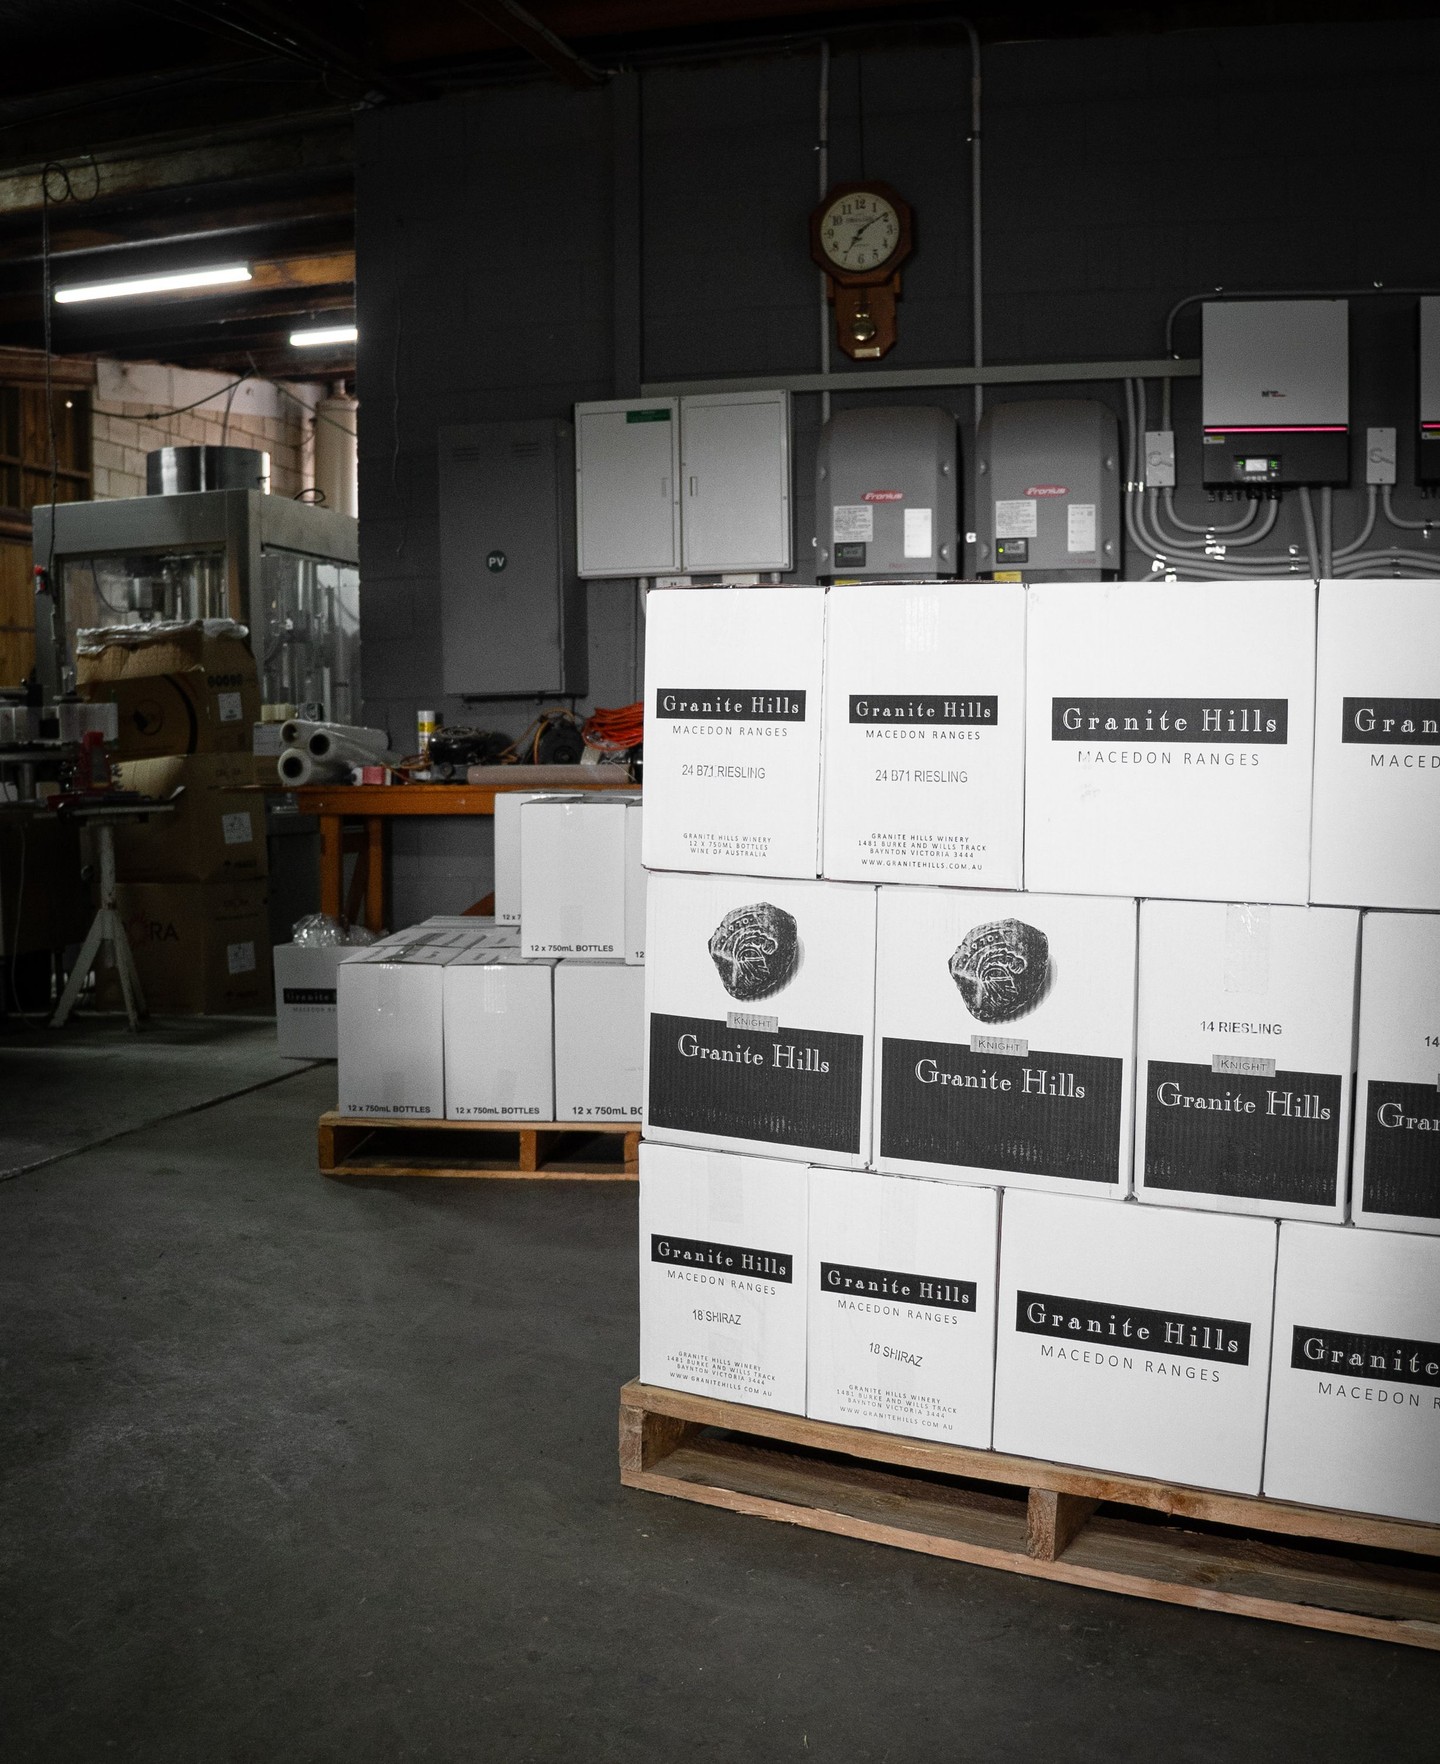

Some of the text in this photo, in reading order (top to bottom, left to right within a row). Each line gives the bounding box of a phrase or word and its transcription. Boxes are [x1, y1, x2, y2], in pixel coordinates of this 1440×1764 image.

[842, 204, 851, 215] 11
[855, 198, 866, 209] 12
[488, 557, 505, 567] PV
[663, 695, 800, 714] Granite Hills
[856, 701, 992, 718] Granite Hills
[1062, 707, 1277, 733] Granite Hills
[672, 725, 788, 737] MACEDON RANGES
[866, 730, 980, 740] MACEDON RANGES
[1184, 752, 1260, 766] RANGES
[682, 764, 766, 779] 24 B71 RIESLING
[875, 770, 968, 783] 24 B71 RIESLING
[683, 832, 715, 840] GRANITE
[861, 859, 983, 870] WWW.GRANITEHILLS.COM.AU
[733, 1016, 771, 1028] KNIGHT
[1200, 1021, 1282, 1035] 14 RIESLING
[677, 1033, 830, 1073] Granite Hills
[978, 1040, 1020, 1052] KNIGHT
[1220, 1059, 1267, 1072] KNIGHT
[915, 1059, 1085, 1098] Granite Hills
[348, 1104, 357, 1112] 12
[365, 1104, 391, 1113] 750mL
[393, 1105, 431, 1114] BOTTLES
[1156, 1081, 1331, 1120] Granite Hills
[455, 1106, 464, 1114] 12
[473, 1106, 499, 1114] 750mL
[501, 1106, 540, 1115] BOTTLES
[573, 1106, 584, 1114] 12
[595, 1106, 627, 1115] 750mL
[658, 1241, 786, 1276] Granite Hills
[668, 1270, 777, 1296] MACEDON RANGES
[827, 1269, 969, 1304] Granite Hills
[693, 1310, 741, 1325] 18 SHIRAZ
[838, 1299, 958, 1325] MACEDON RANGES
[1026, 1302, 1239, 1354] Granite Hills
[678, 1351, 761, 1371] GRANITE HILLS WINERY
[869, 1342, 923, 1367] 18 SHIRAZ
[1041, 1344, 1220, 1383] MACEDON RANGES
[1304, 1337, 1439, 1376] Granite
[667, 1355, 684, 1363] 1481
[687, 1359, 709, 1368] BURKE
[729, 1367, 751, 1376] WILLS
[754, 1372, 776, 1381] TRACK
[677, 1364, 765, 1385] BAYNTON VICTORIA 3444
[837, 1389, 957, 1414] 1481 BURKE AND WILLS TRACK
[849, 1384, 882, 1395] GRANITE
[910, 1394, 941, 1404] WINERY
[1318, 1382, 1419, 1407] MACEDON
[848, 1398, 945, 1418] BAYNTON VICTORIA 3444
